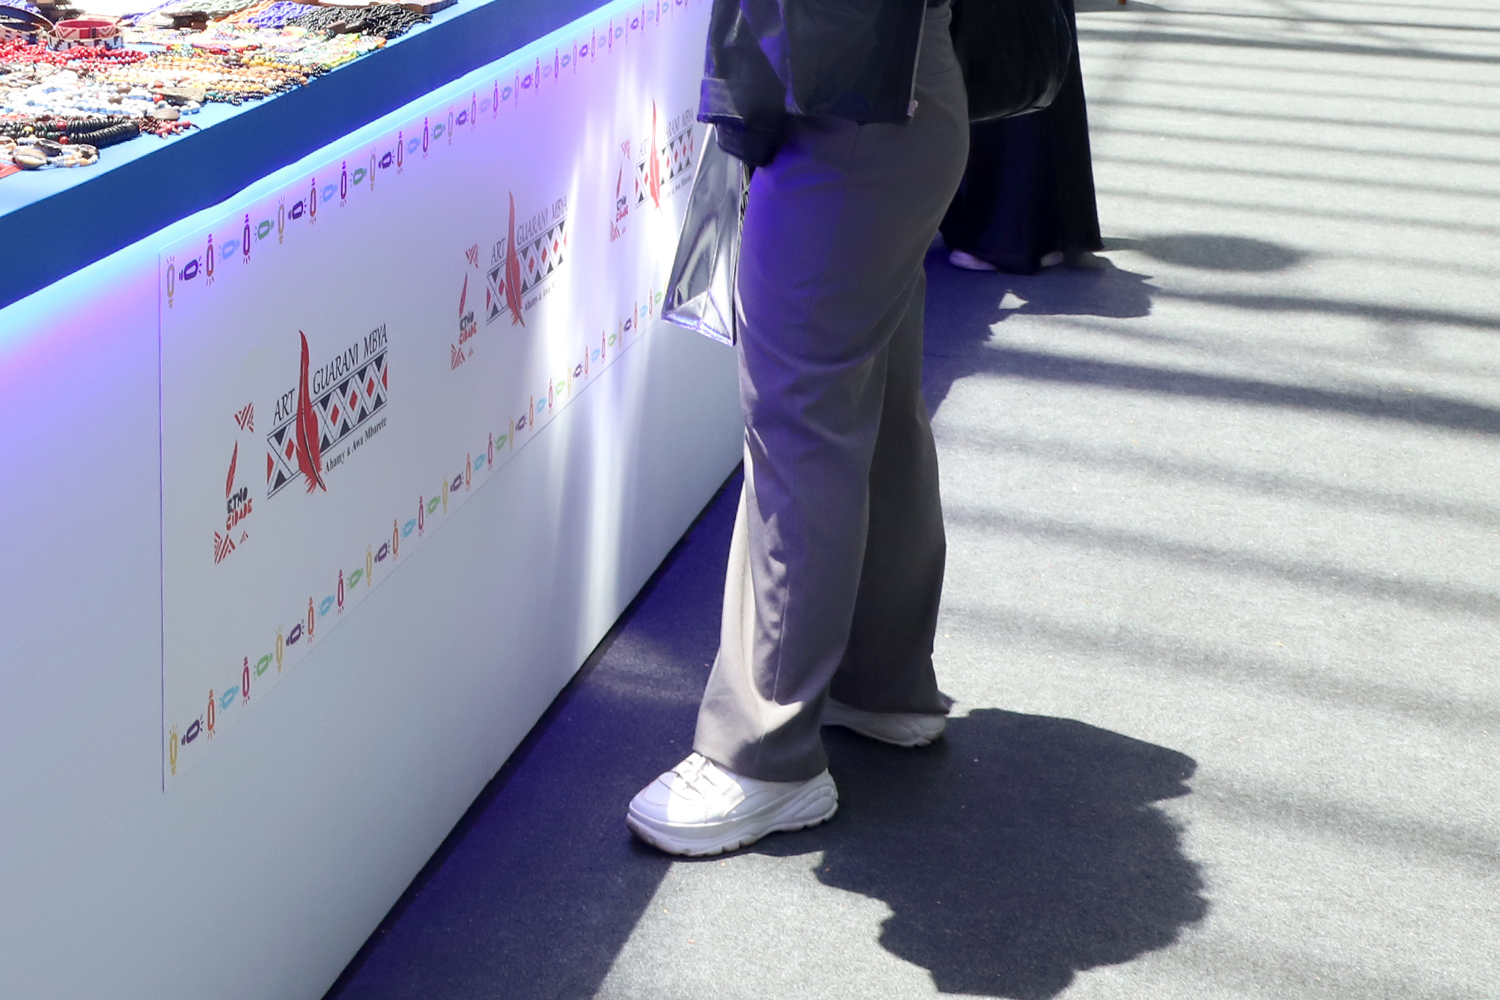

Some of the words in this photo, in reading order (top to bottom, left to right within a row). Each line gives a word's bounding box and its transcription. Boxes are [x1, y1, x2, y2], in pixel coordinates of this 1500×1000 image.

[490, 237, 506, 266] ART
[516, 208, 549, 246] GUARANI
[273, 387, 295, 426] ART
[313, 343, 358, 394] GUARANI
[363, 323, 387, 359] MBYA
[227, 487, 248, 514] ETNO
